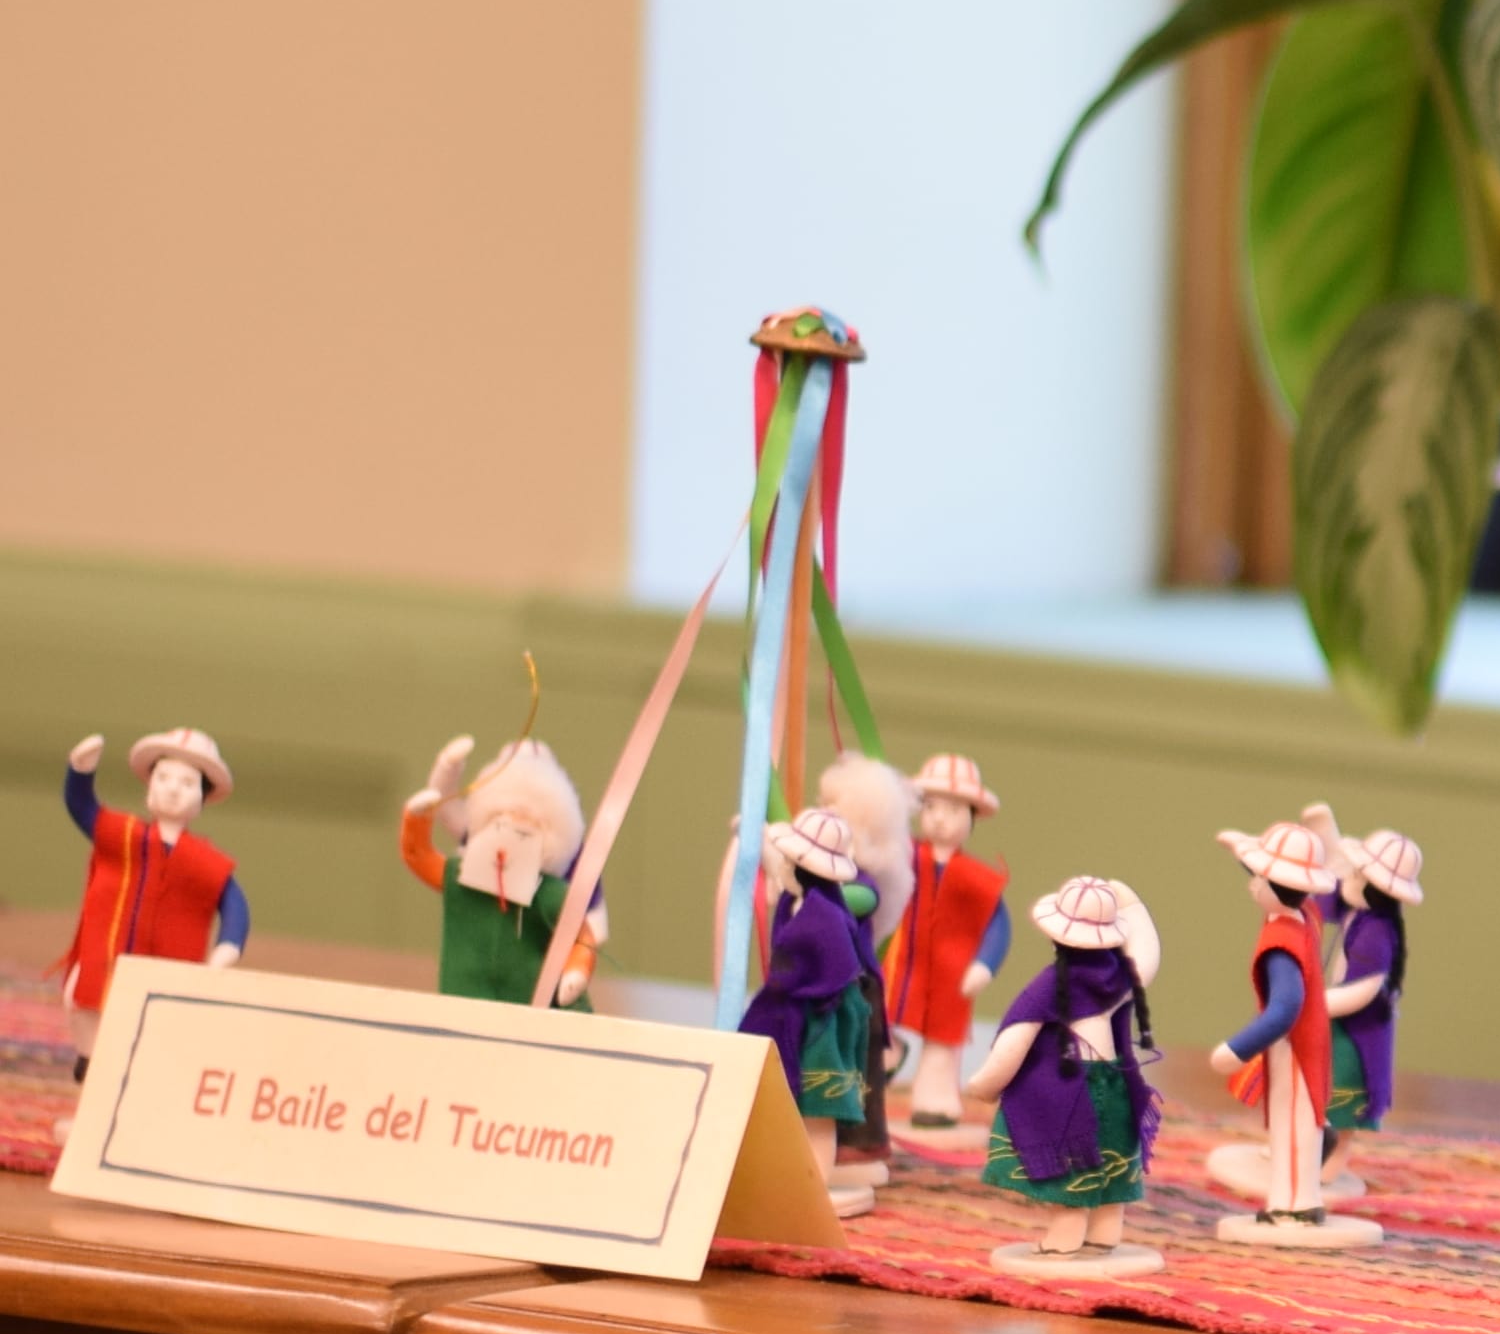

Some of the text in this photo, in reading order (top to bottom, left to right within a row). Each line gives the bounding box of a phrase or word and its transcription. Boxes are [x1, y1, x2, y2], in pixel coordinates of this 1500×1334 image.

[193, 1069, 614, 1168] El Baile del Tucuman
